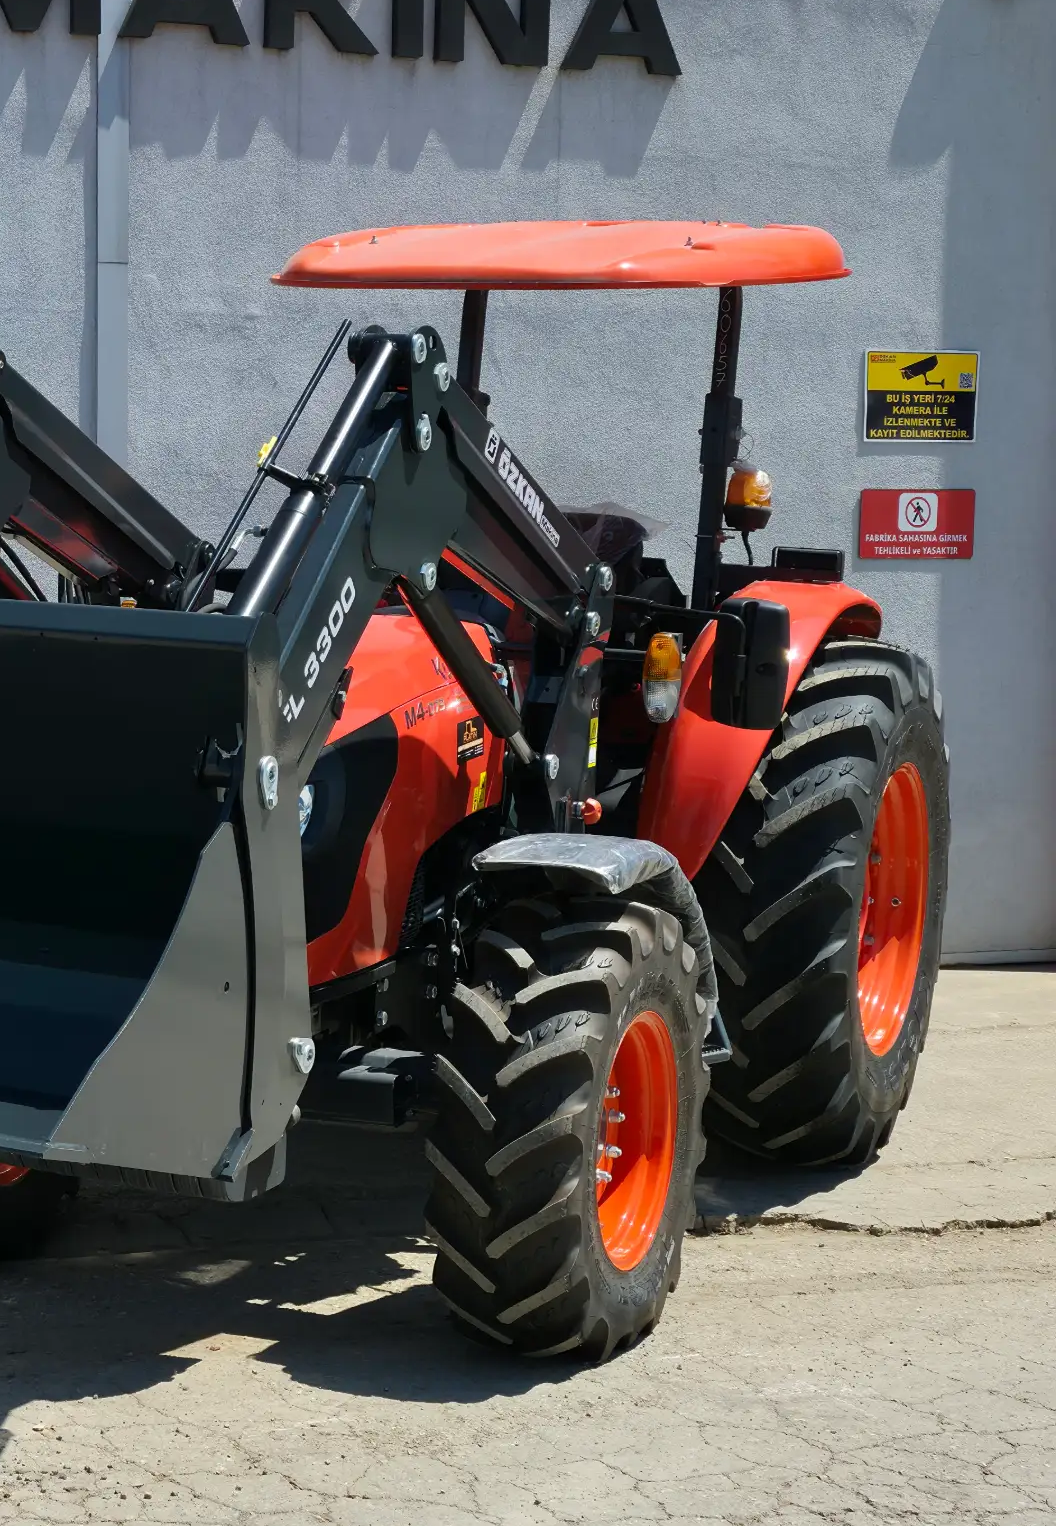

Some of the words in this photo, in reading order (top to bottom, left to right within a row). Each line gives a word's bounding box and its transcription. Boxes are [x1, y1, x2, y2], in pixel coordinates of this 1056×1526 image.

[886, 394, 899, 403] BU
[901, 393, 911, 404] İŞ
[913, 393, 935, 403] YERİ
[892, 406, 932, 415] KAMERA
[934, 405, 948, 415] İLE
[884, 416, 942, 426] İZLENMEKTE
[944, 418, 956, 426] VE
[870, 428, 897, 438] KAYIT
[900, 428, 969, 438] EDİLMEKTEDİR.
[497, 446, 545, 525] ÖZKAN
[865, 533, 897, 542] FABRİKA
[898, 534, 937, 542] SAHASINA
[939, 533, 968, 542] GİRMEK
[874, 545, 911, 555] TEHLİKELİ
[922, 546, 958, 555] YASAKTIR
[304, 576, 356, 689] 3300
